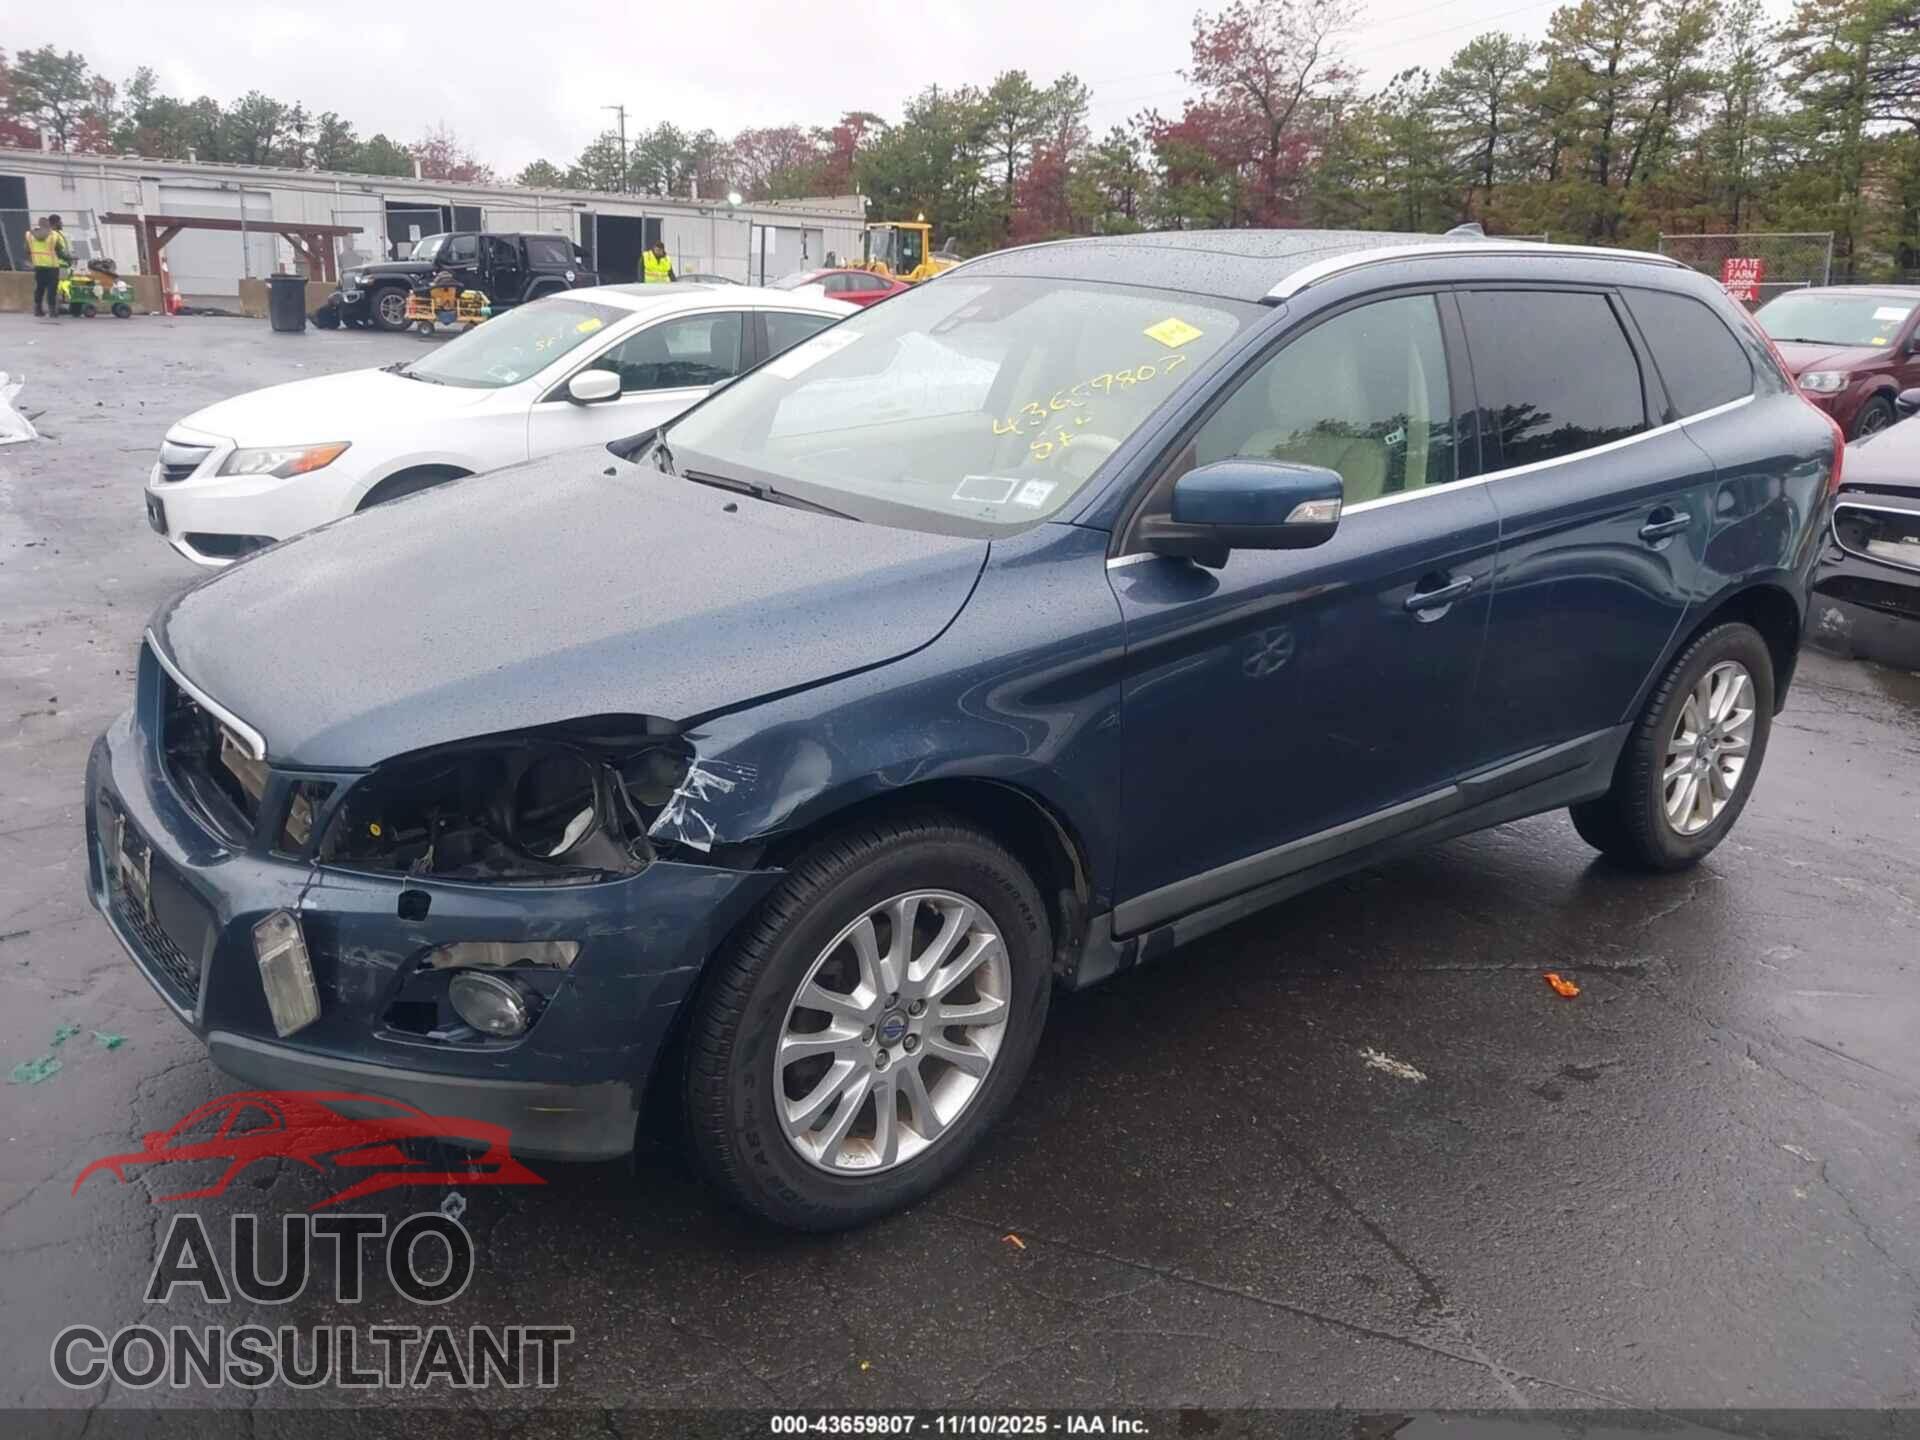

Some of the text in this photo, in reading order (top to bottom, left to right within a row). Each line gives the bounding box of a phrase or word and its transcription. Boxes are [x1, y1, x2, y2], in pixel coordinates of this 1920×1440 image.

[1727, 258, 1760, 269] STATE
[1727, 269, 1757, 280] FARM
[1727, 290, 1753, 301] AREA
